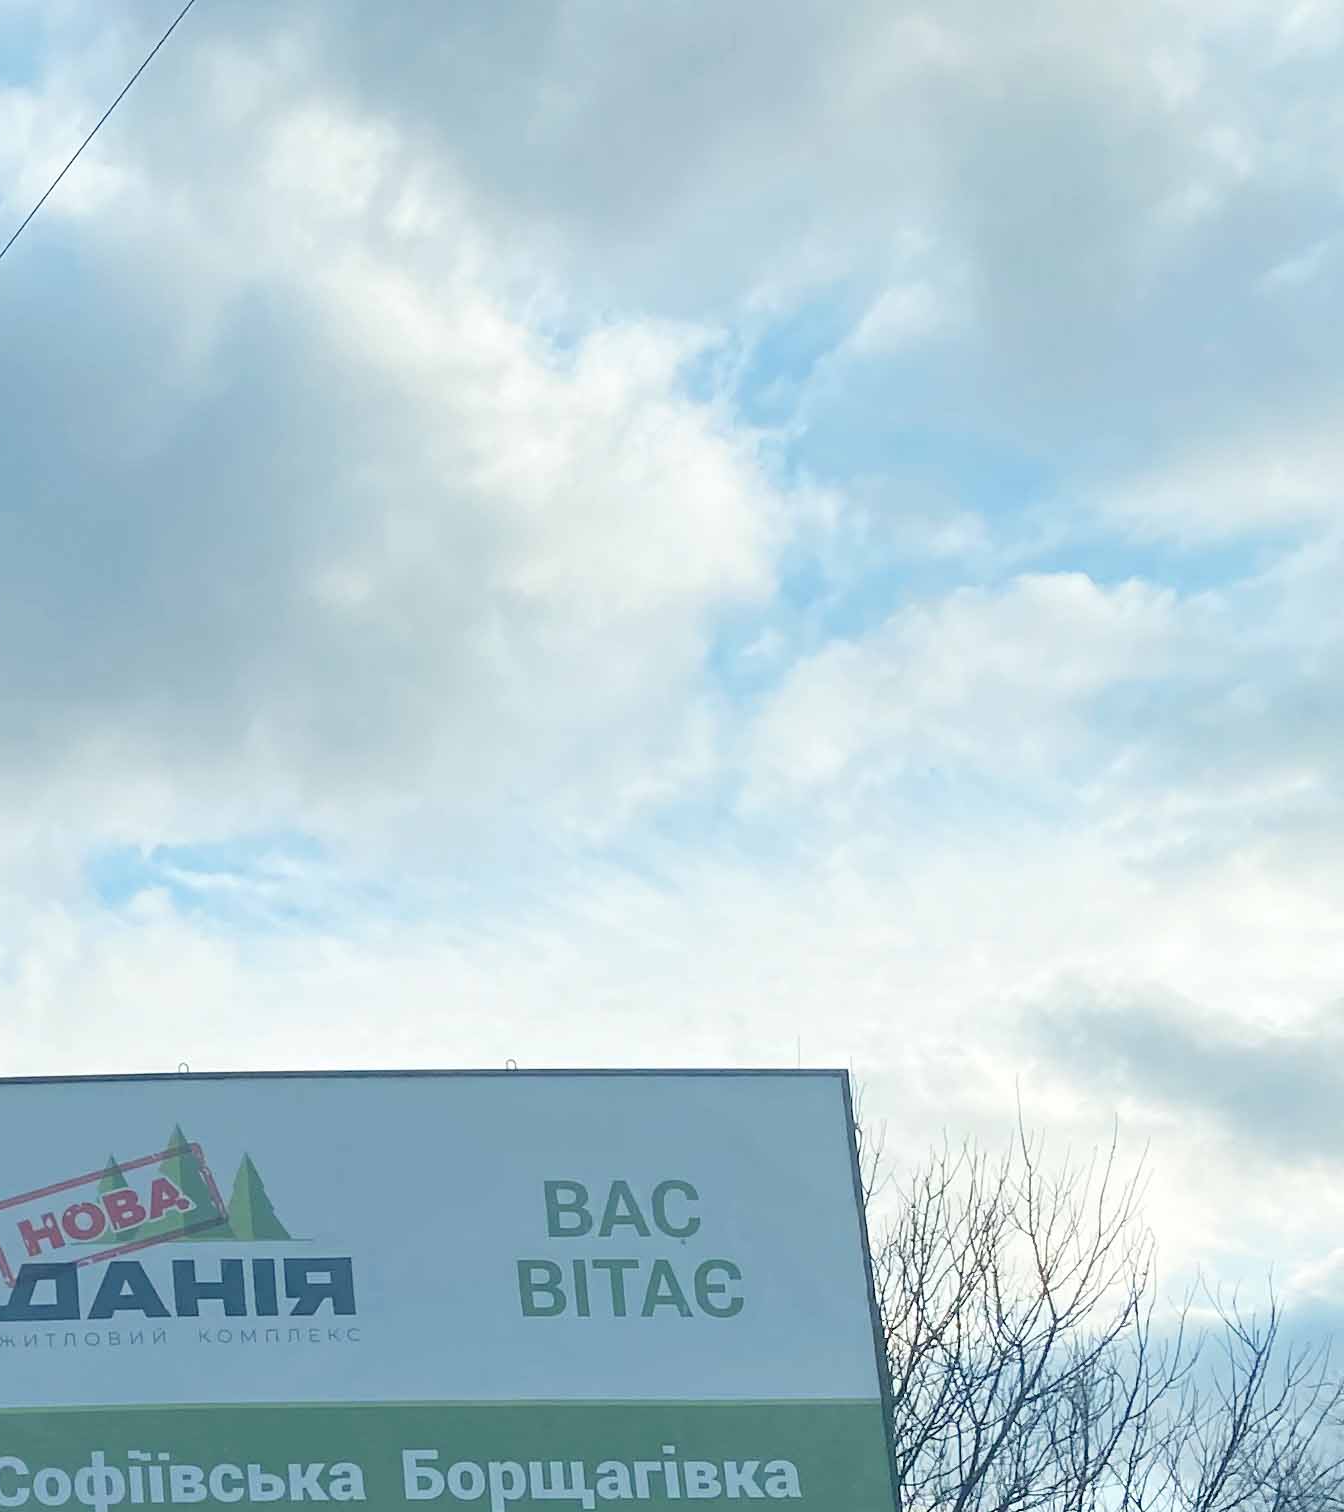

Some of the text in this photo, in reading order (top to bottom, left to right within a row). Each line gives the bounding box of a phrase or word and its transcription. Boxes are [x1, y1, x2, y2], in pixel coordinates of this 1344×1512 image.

[17, 1176, 192, 1257] НОВА
[543, 1178, 702, 1239] ВАС
[516, 1257, 746, 1319] ВІТАЄ
[198, 1326, 362, 1345] КОМПЛЕКС
[401, 1445, 803, 1512] Борщагівка
